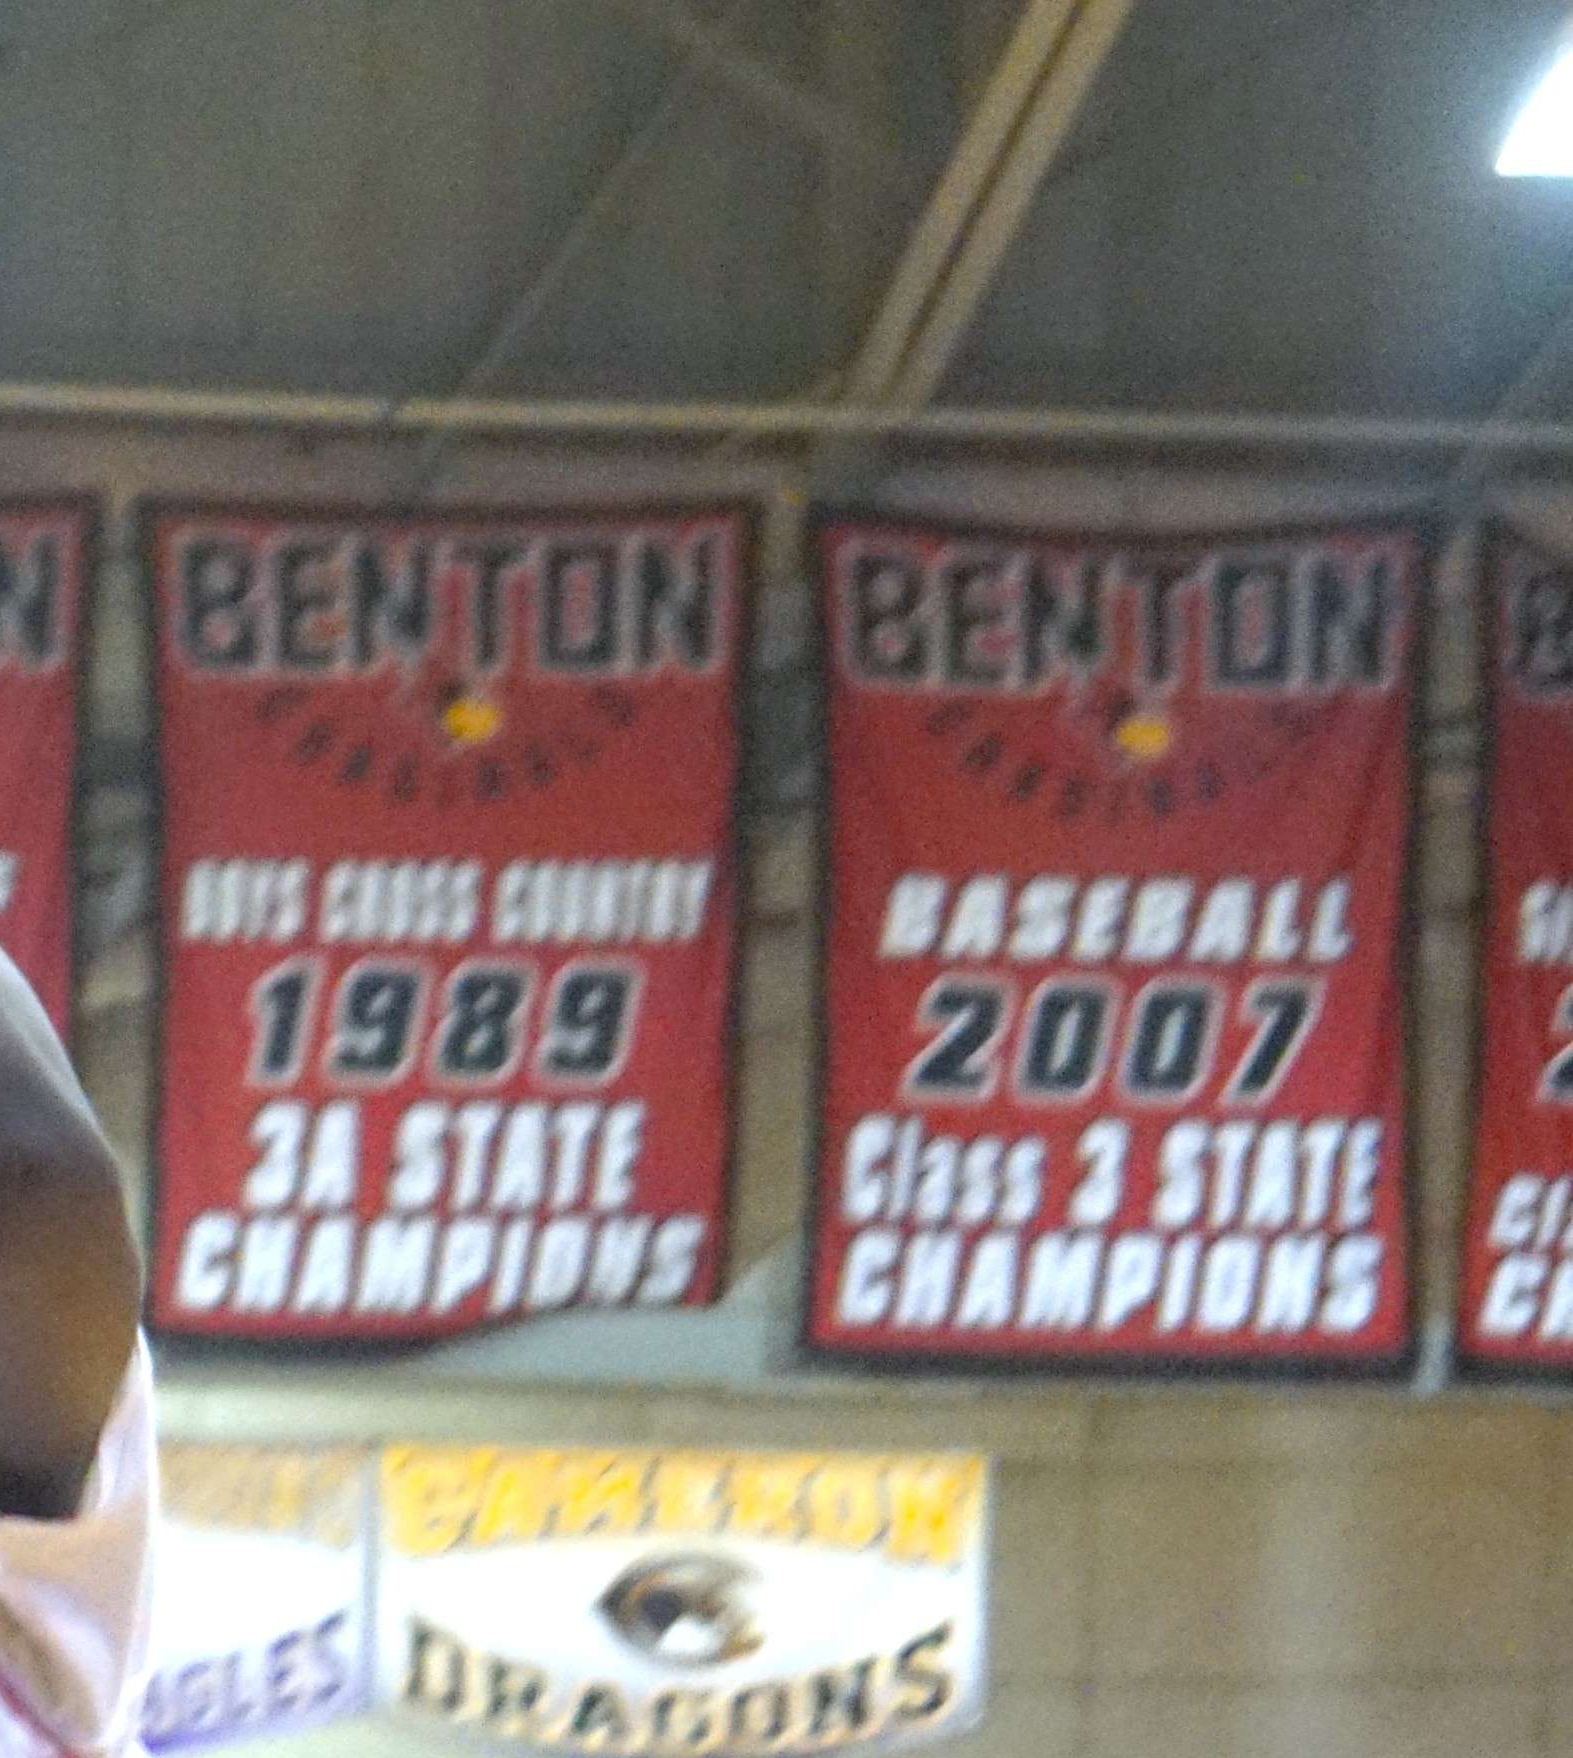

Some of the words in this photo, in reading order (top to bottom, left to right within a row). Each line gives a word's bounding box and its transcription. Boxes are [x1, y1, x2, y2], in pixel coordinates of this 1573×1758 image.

[170, 525, 733, 681] BENTON
[836, 540, 1413, 694] BENTON
[318, 857, 484, 943] CROSS
[488, 857, 716, 945] COUNTRY
[876, 872, 1356, 965] BASEBALL
[245, 954, 646, 1092] 1989
[897, 972, 1326, 1106] 2007
[245, 1097, 363, 1212] 3A
[386, 1099, 650, 1214] STATE
[842, 1113, 1050, 1227] Class
[1066, 1115, 1131, 1227] 3
[1150, 1116, 1382, 1231] STATE
[175, 1212, 707, 1316] CHAMPIONS
[834, 1227, 1386, 1337] CHAMPIONS
[138, 1607, 353, 1734] AGLES
[399, 1609, 956, 1757] DRAGONS
